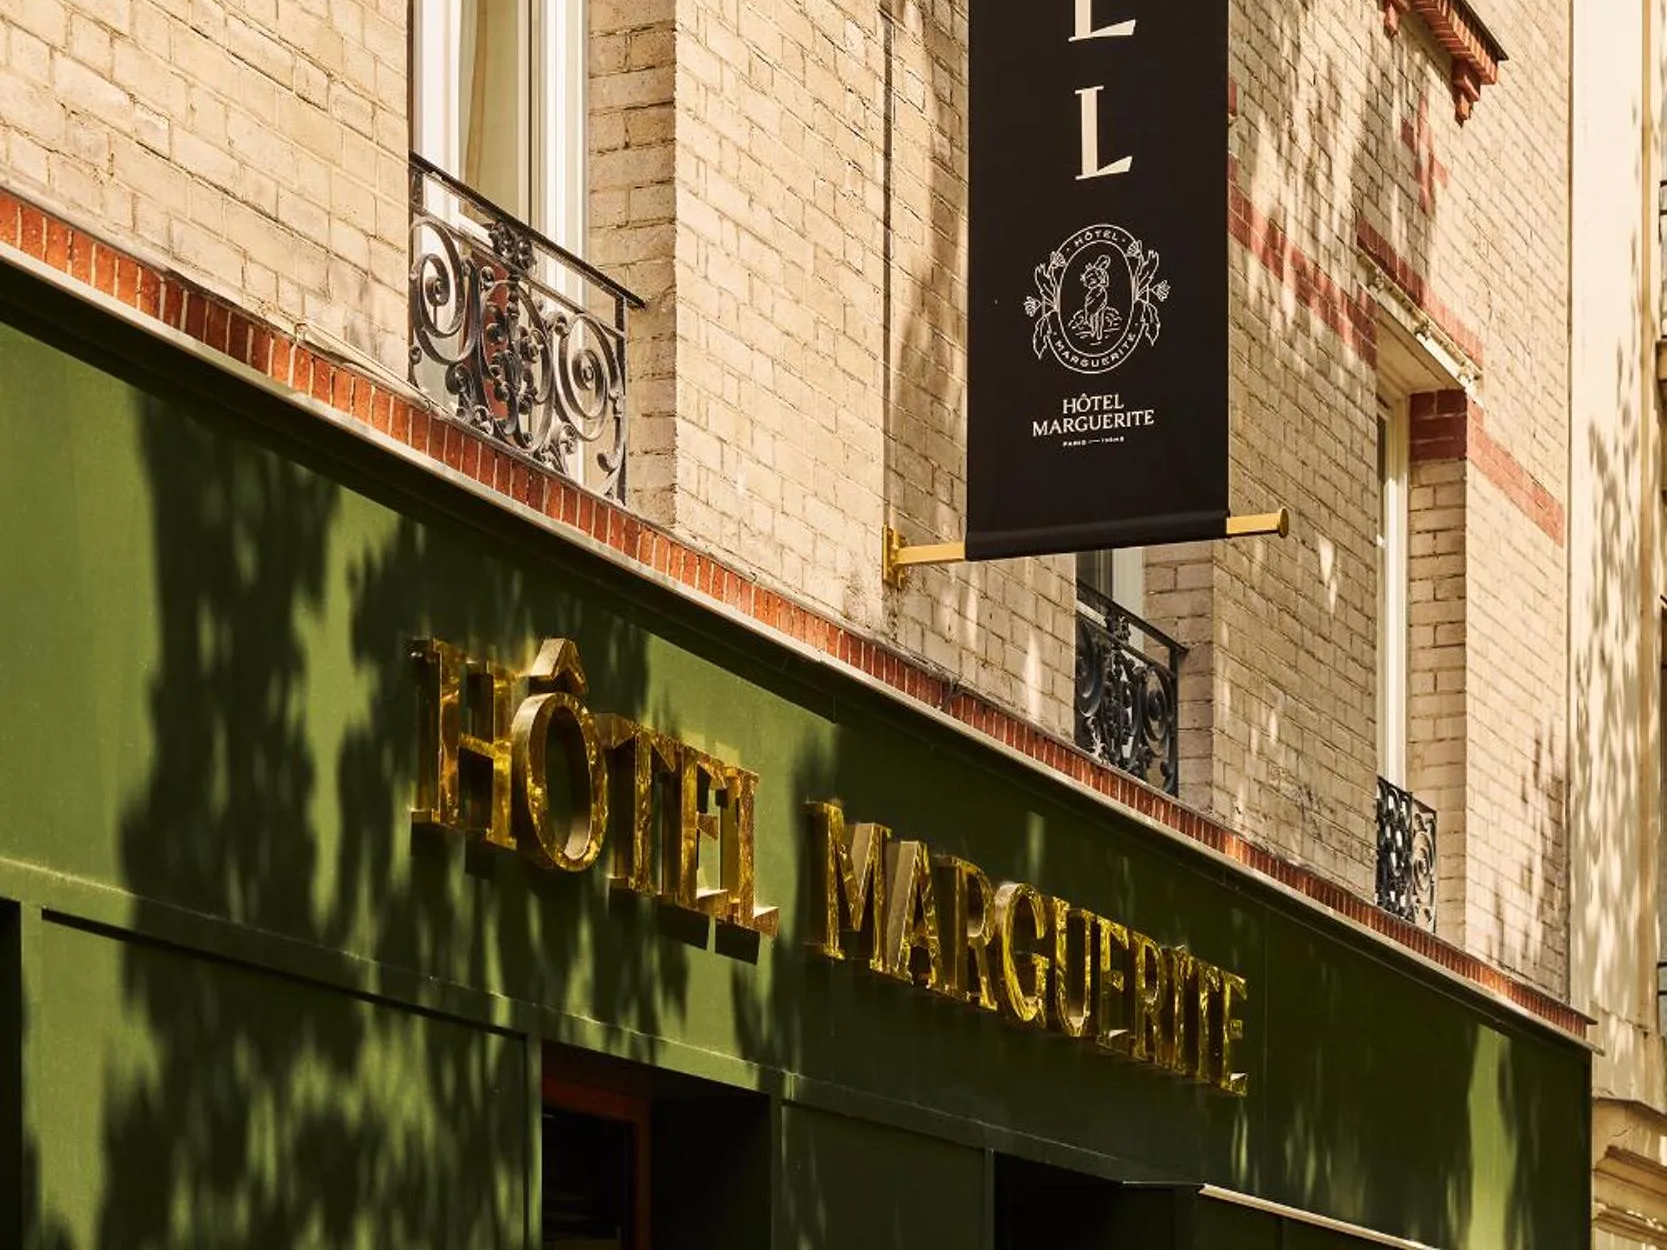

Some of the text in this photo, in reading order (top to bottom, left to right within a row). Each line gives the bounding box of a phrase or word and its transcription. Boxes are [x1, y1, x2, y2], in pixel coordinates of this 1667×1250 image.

[1055, 333, 1137, 367] MARGUERITE
[1063, 393, 1124, 414] HÔTEL
[1032, 409, 1155, 437] MARGUERITE
[410, 638, 1248, 1096] HÔTEL MARGUERITE
